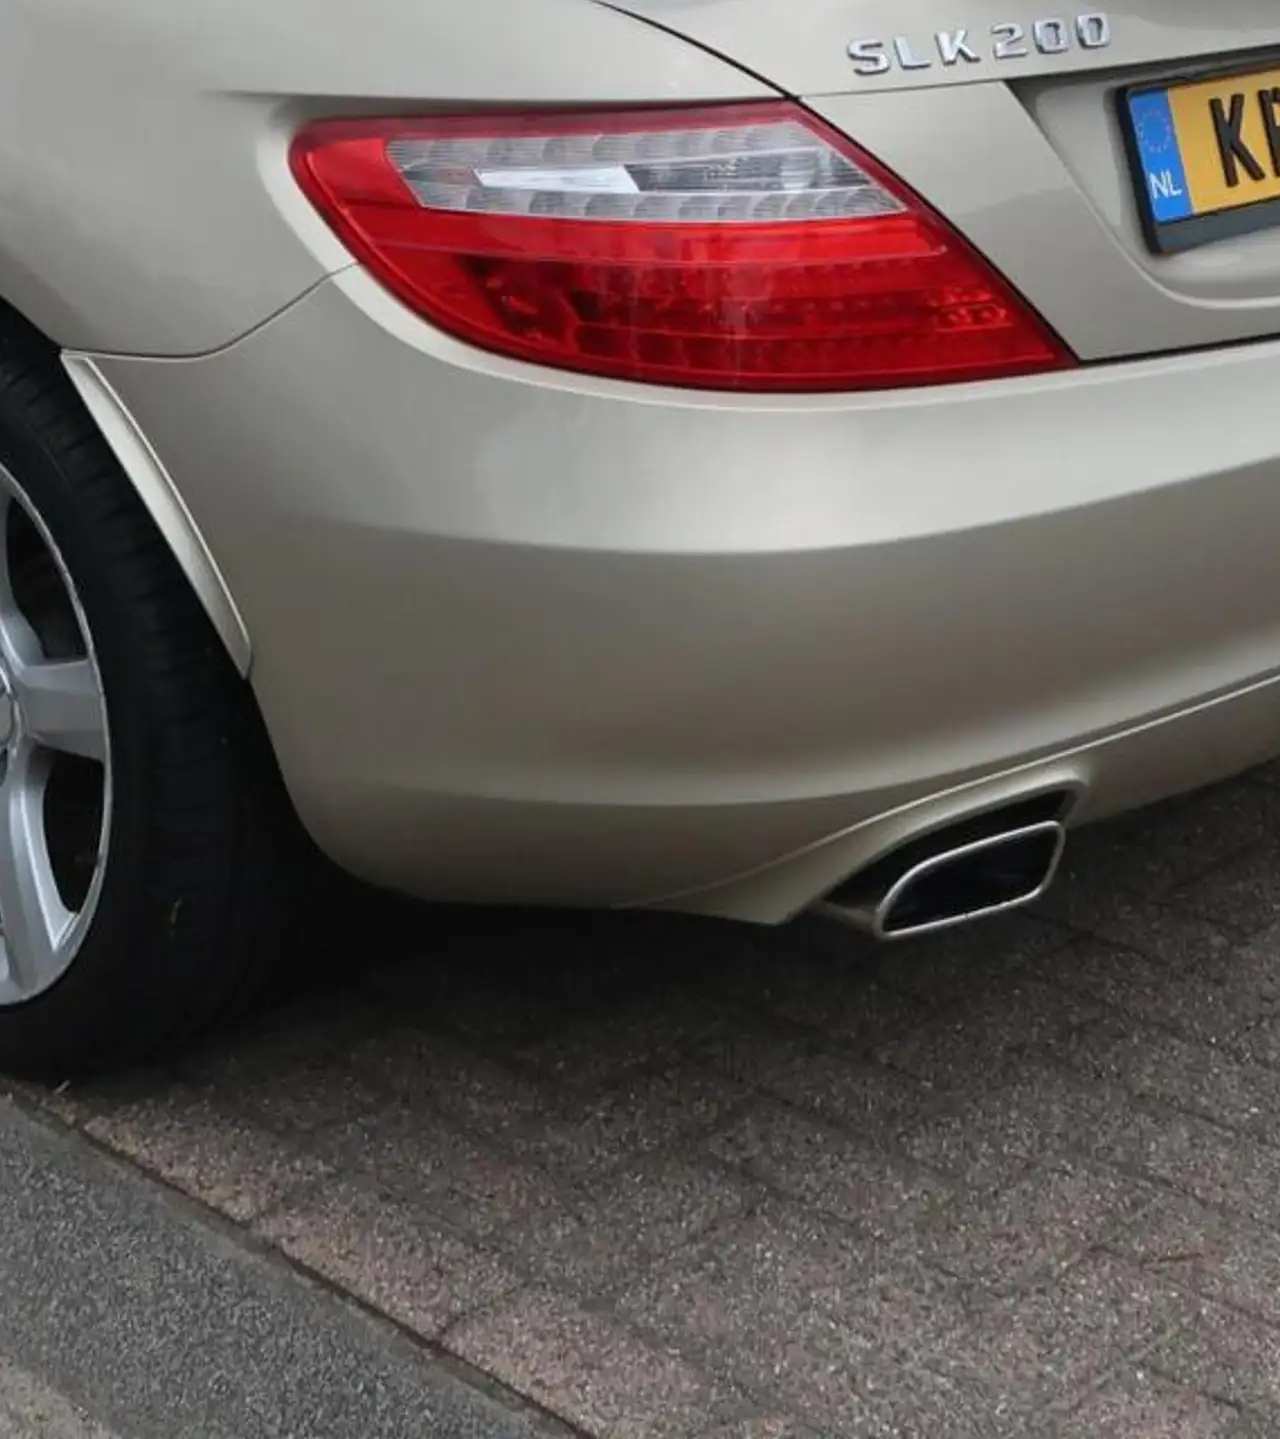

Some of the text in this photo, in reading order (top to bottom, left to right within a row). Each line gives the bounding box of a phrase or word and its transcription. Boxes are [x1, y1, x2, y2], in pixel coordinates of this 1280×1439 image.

[847, 12, 1112, 75] SLK 200
[1148, 170, 1182, 200] NL
